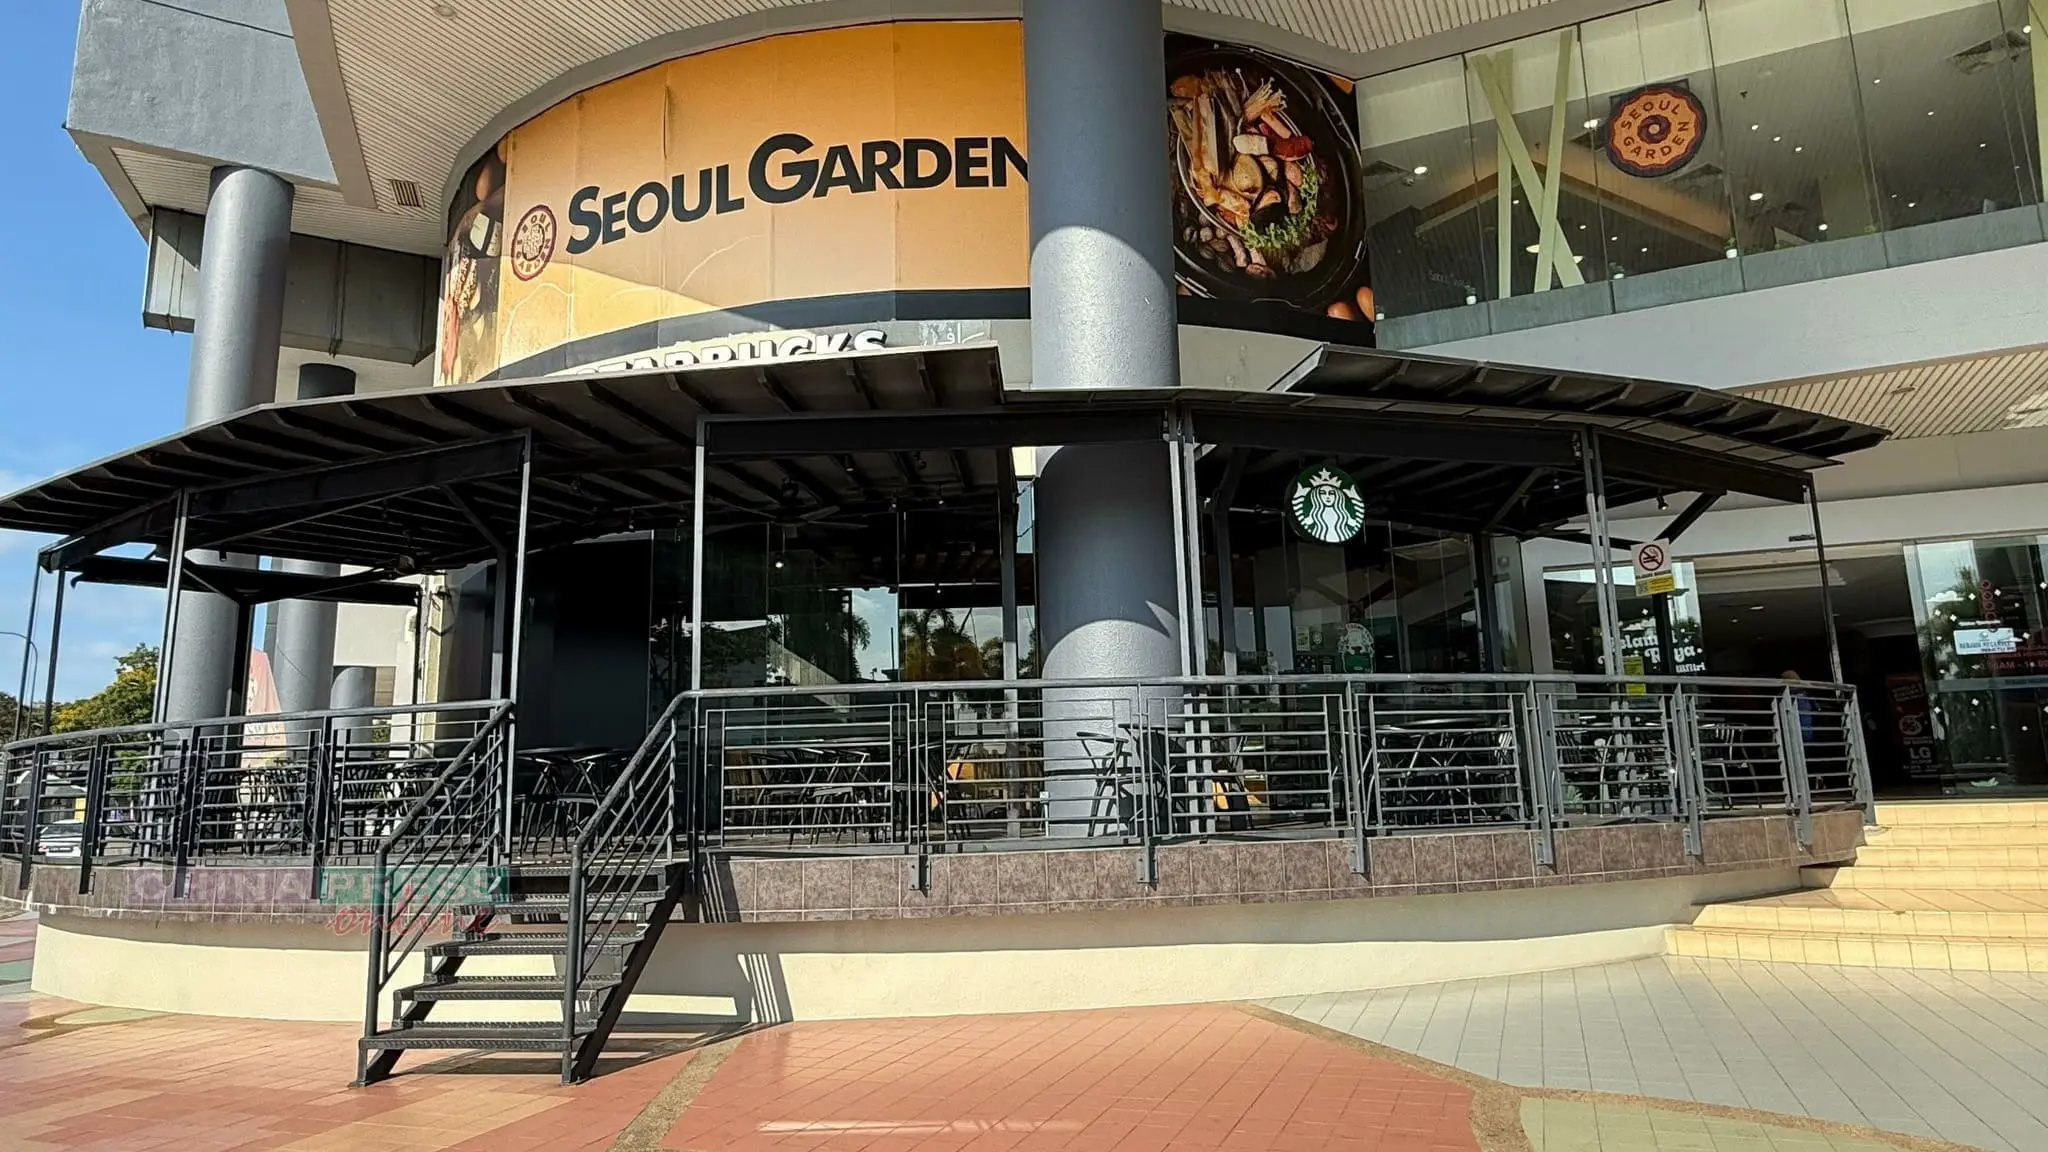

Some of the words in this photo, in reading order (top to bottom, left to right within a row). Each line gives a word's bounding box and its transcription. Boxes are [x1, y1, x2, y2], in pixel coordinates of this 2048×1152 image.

[1621, 99, 1681, 129] SEOUL
[1623, 121, 1689, 160] GARDEN
[566, 163, 745, 255] SEOUL
[748, 133, 1028, 204] GARDEN
